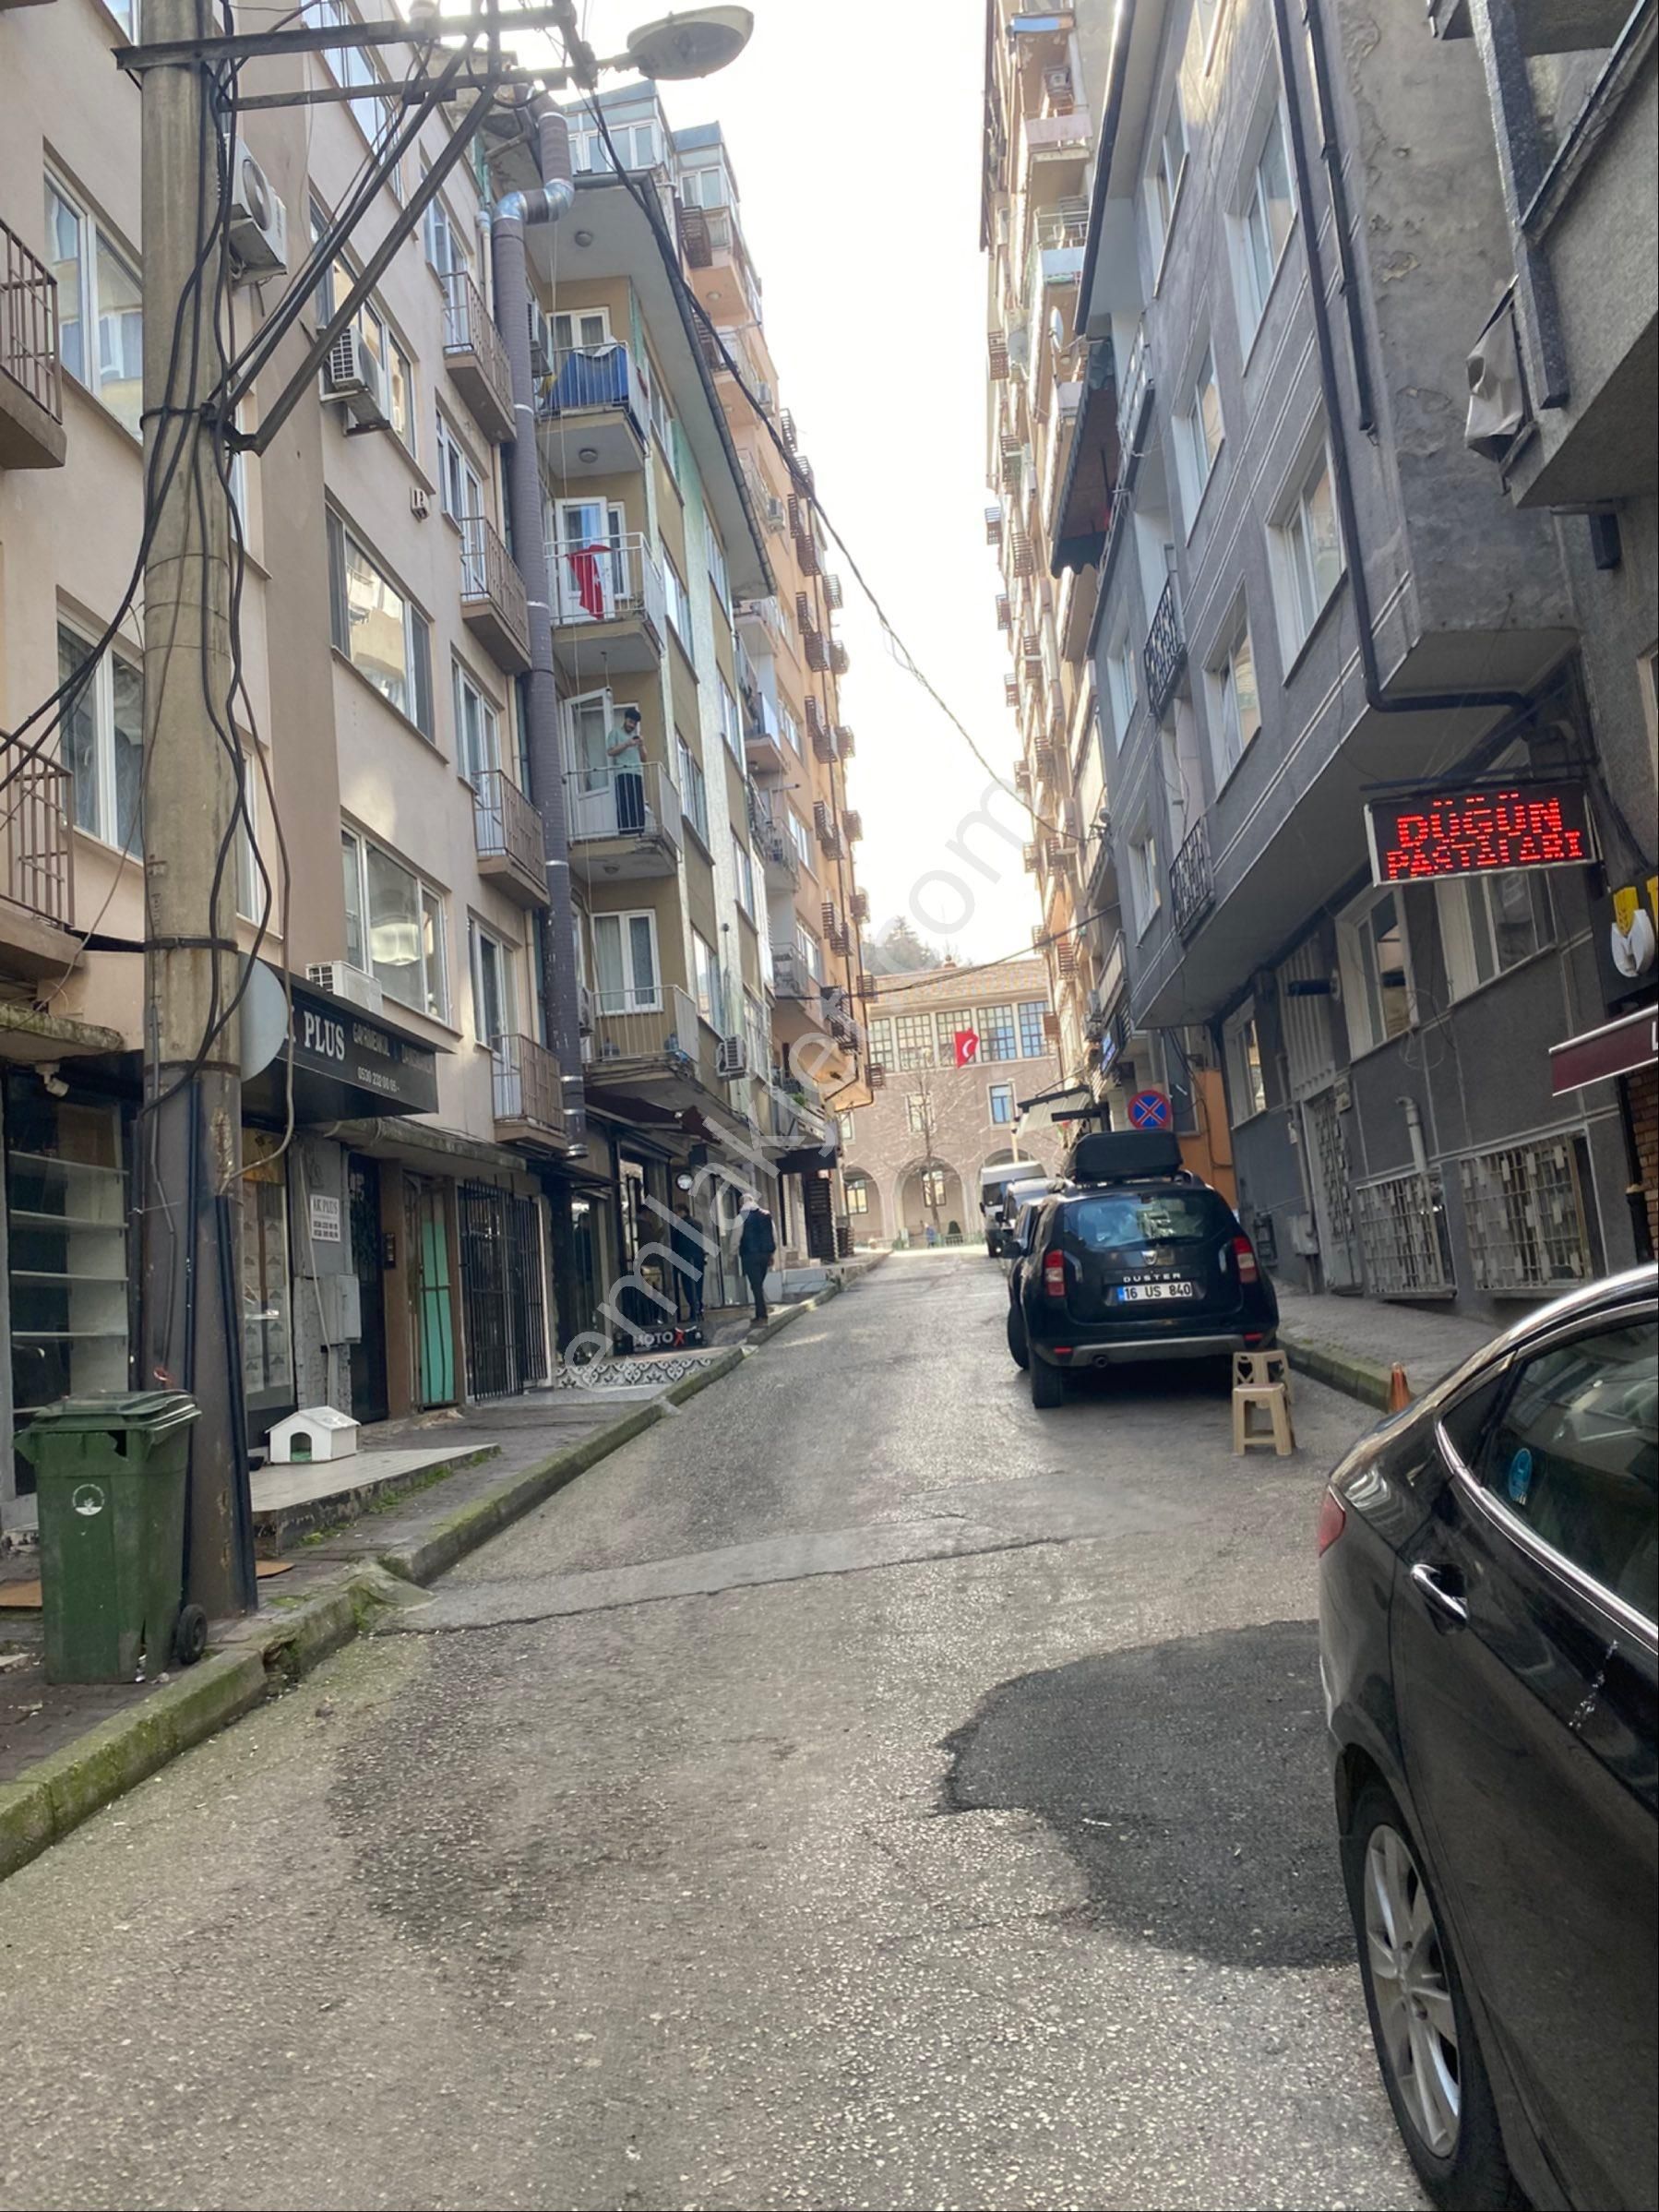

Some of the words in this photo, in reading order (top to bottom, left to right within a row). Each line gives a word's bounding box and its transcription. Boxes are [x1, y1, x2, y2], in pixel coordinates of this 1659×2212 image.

[304, 1010, 345, 1061] PLUS
[1123, 1273, 1181, 1283] DUSTER
[1125, 1286, 1138, 1299] 16
[1144, 1285, 1162, 1298] US
[1168, 1284, 1191, 1297] 840
